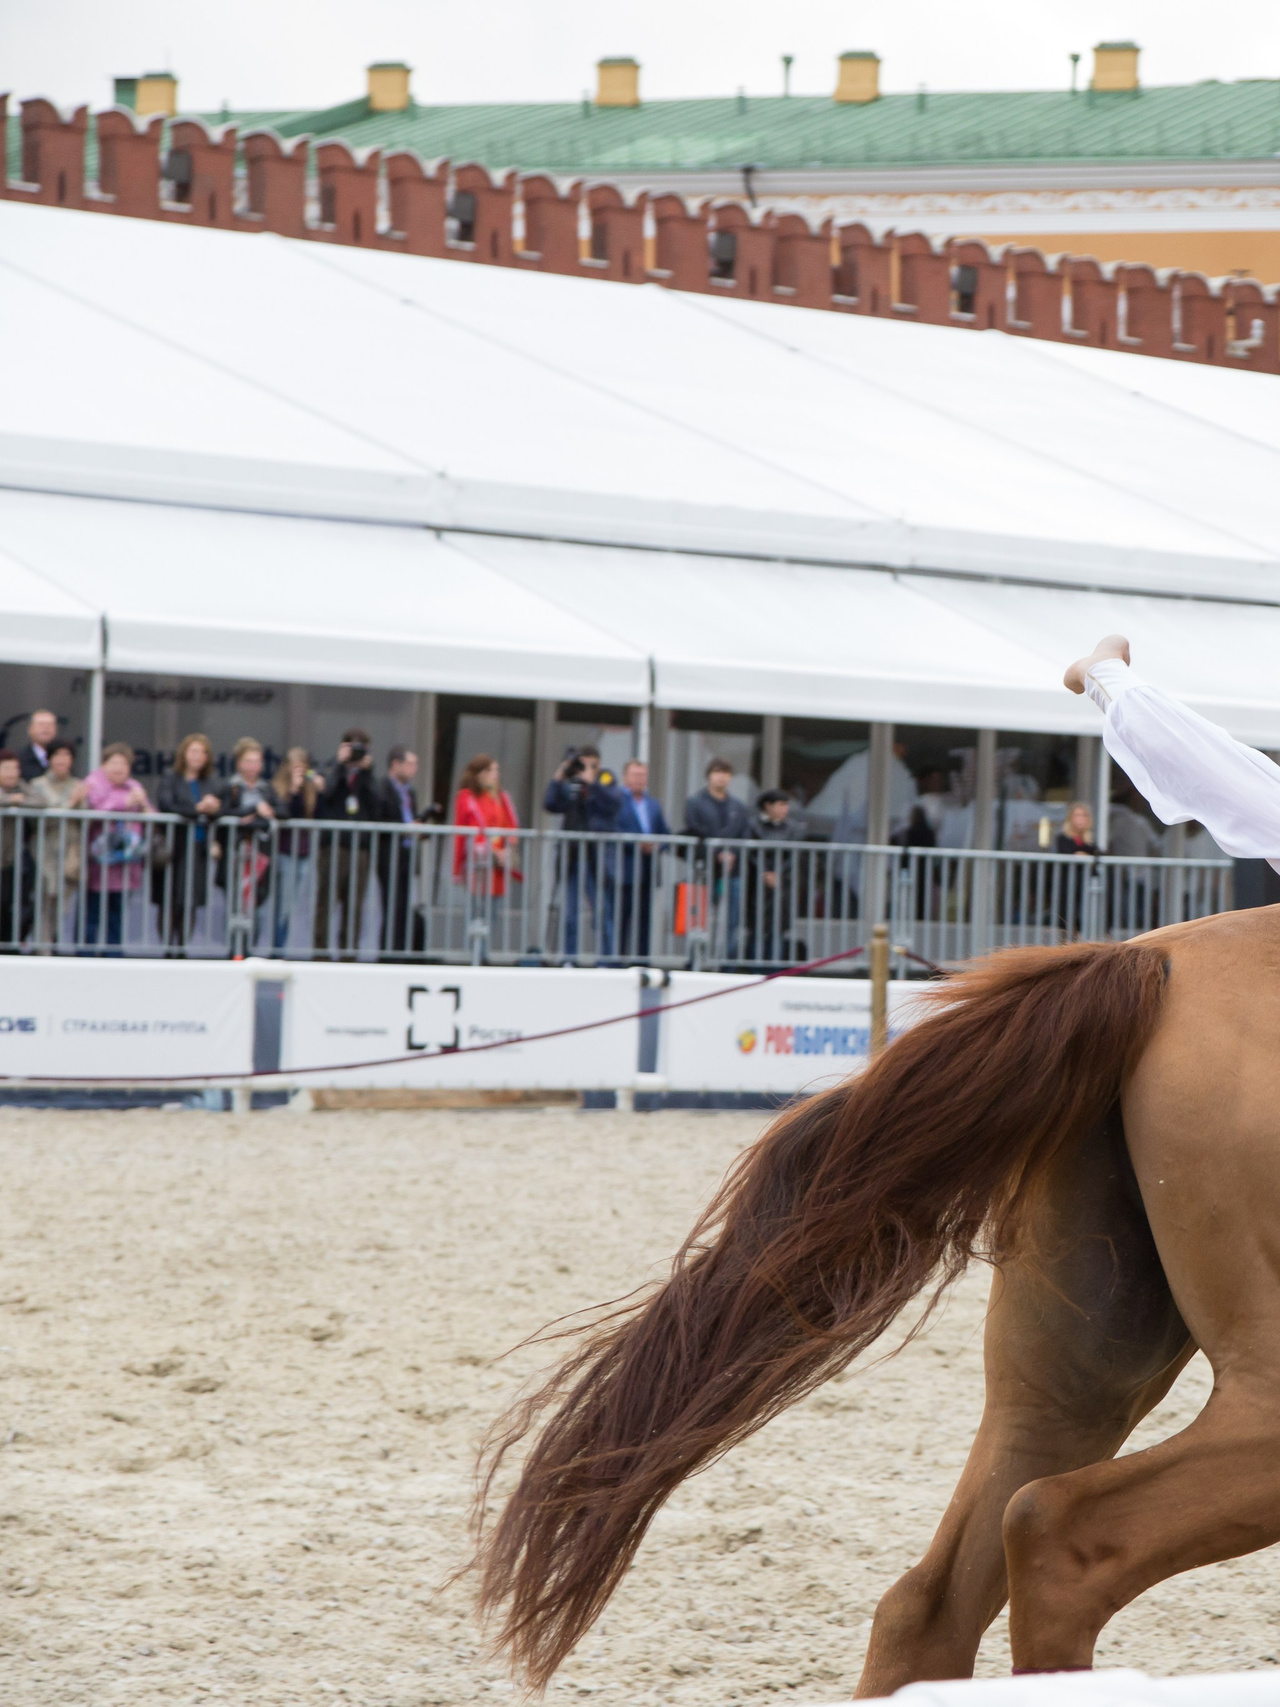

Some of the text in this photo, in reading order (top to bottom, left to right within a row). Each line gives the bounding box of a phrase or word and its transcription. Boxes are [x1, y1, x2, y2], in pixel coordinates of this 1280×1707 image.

[71, 677, 195, 702] ГЕРАЛЬНЫЙ
[62, 1019, 208, 1033] СТРАХОВАЯ ГРУППА
